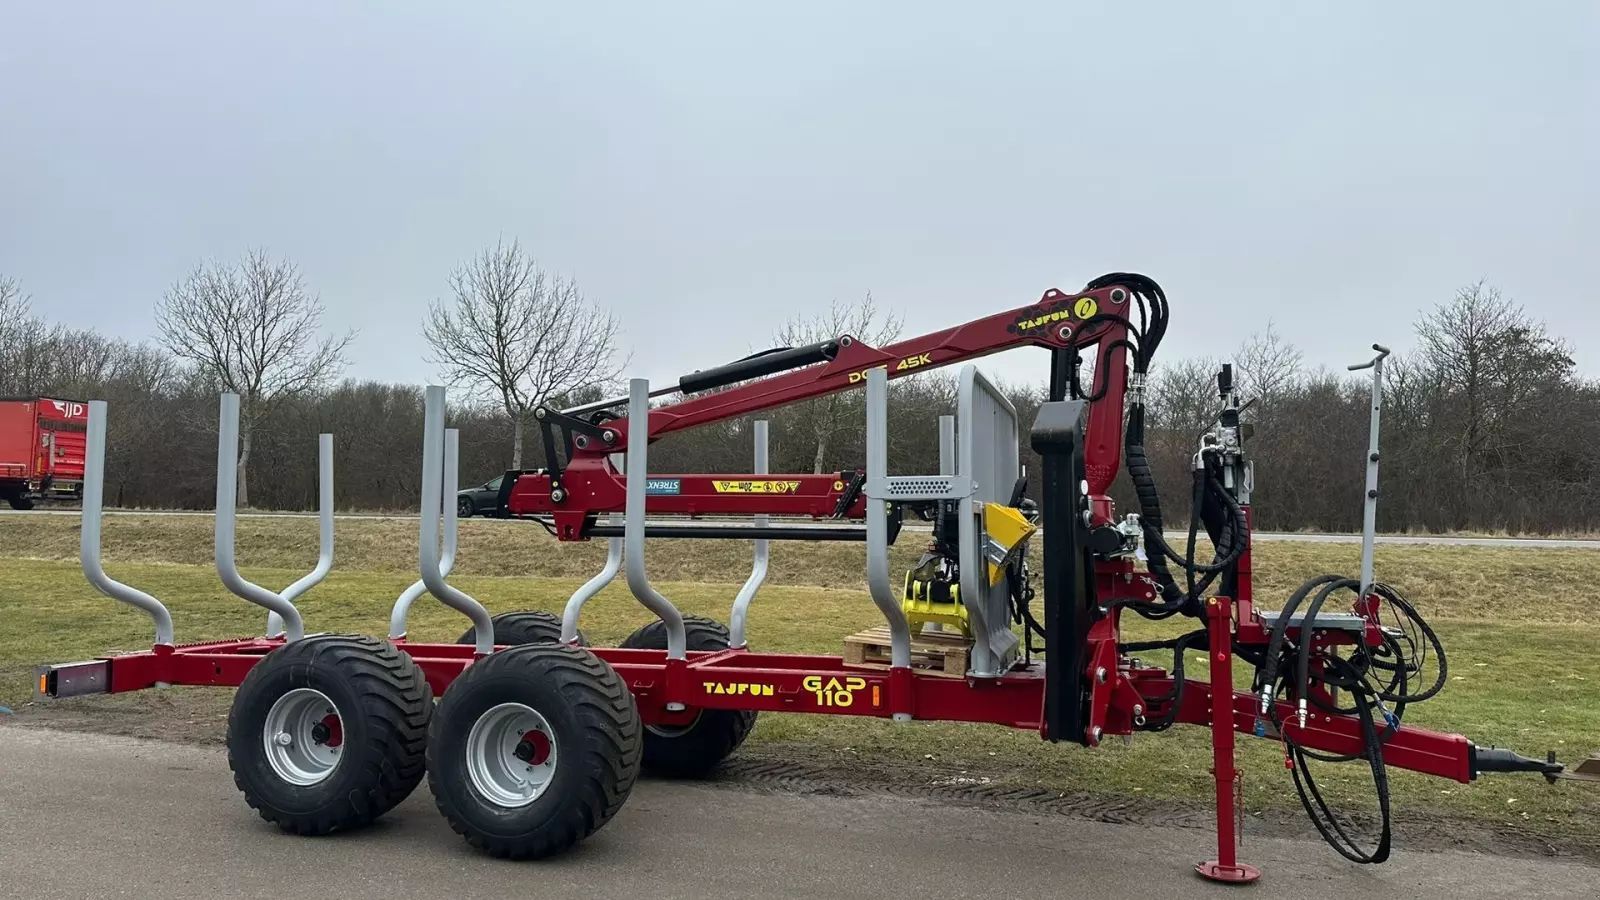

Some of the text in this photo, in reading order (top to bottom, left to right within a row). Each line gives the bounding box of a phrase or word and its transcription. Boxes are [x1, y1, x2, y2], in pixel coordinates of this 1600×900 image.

[1018, 309, 1070, 330] TAJFUN
[896, 352, 932, 371] 45K
[648, 481, 679, 490] STRENX
[703, 675, 866, 696] TAJFUN GAP
[816, 690, 853, 707] 110
